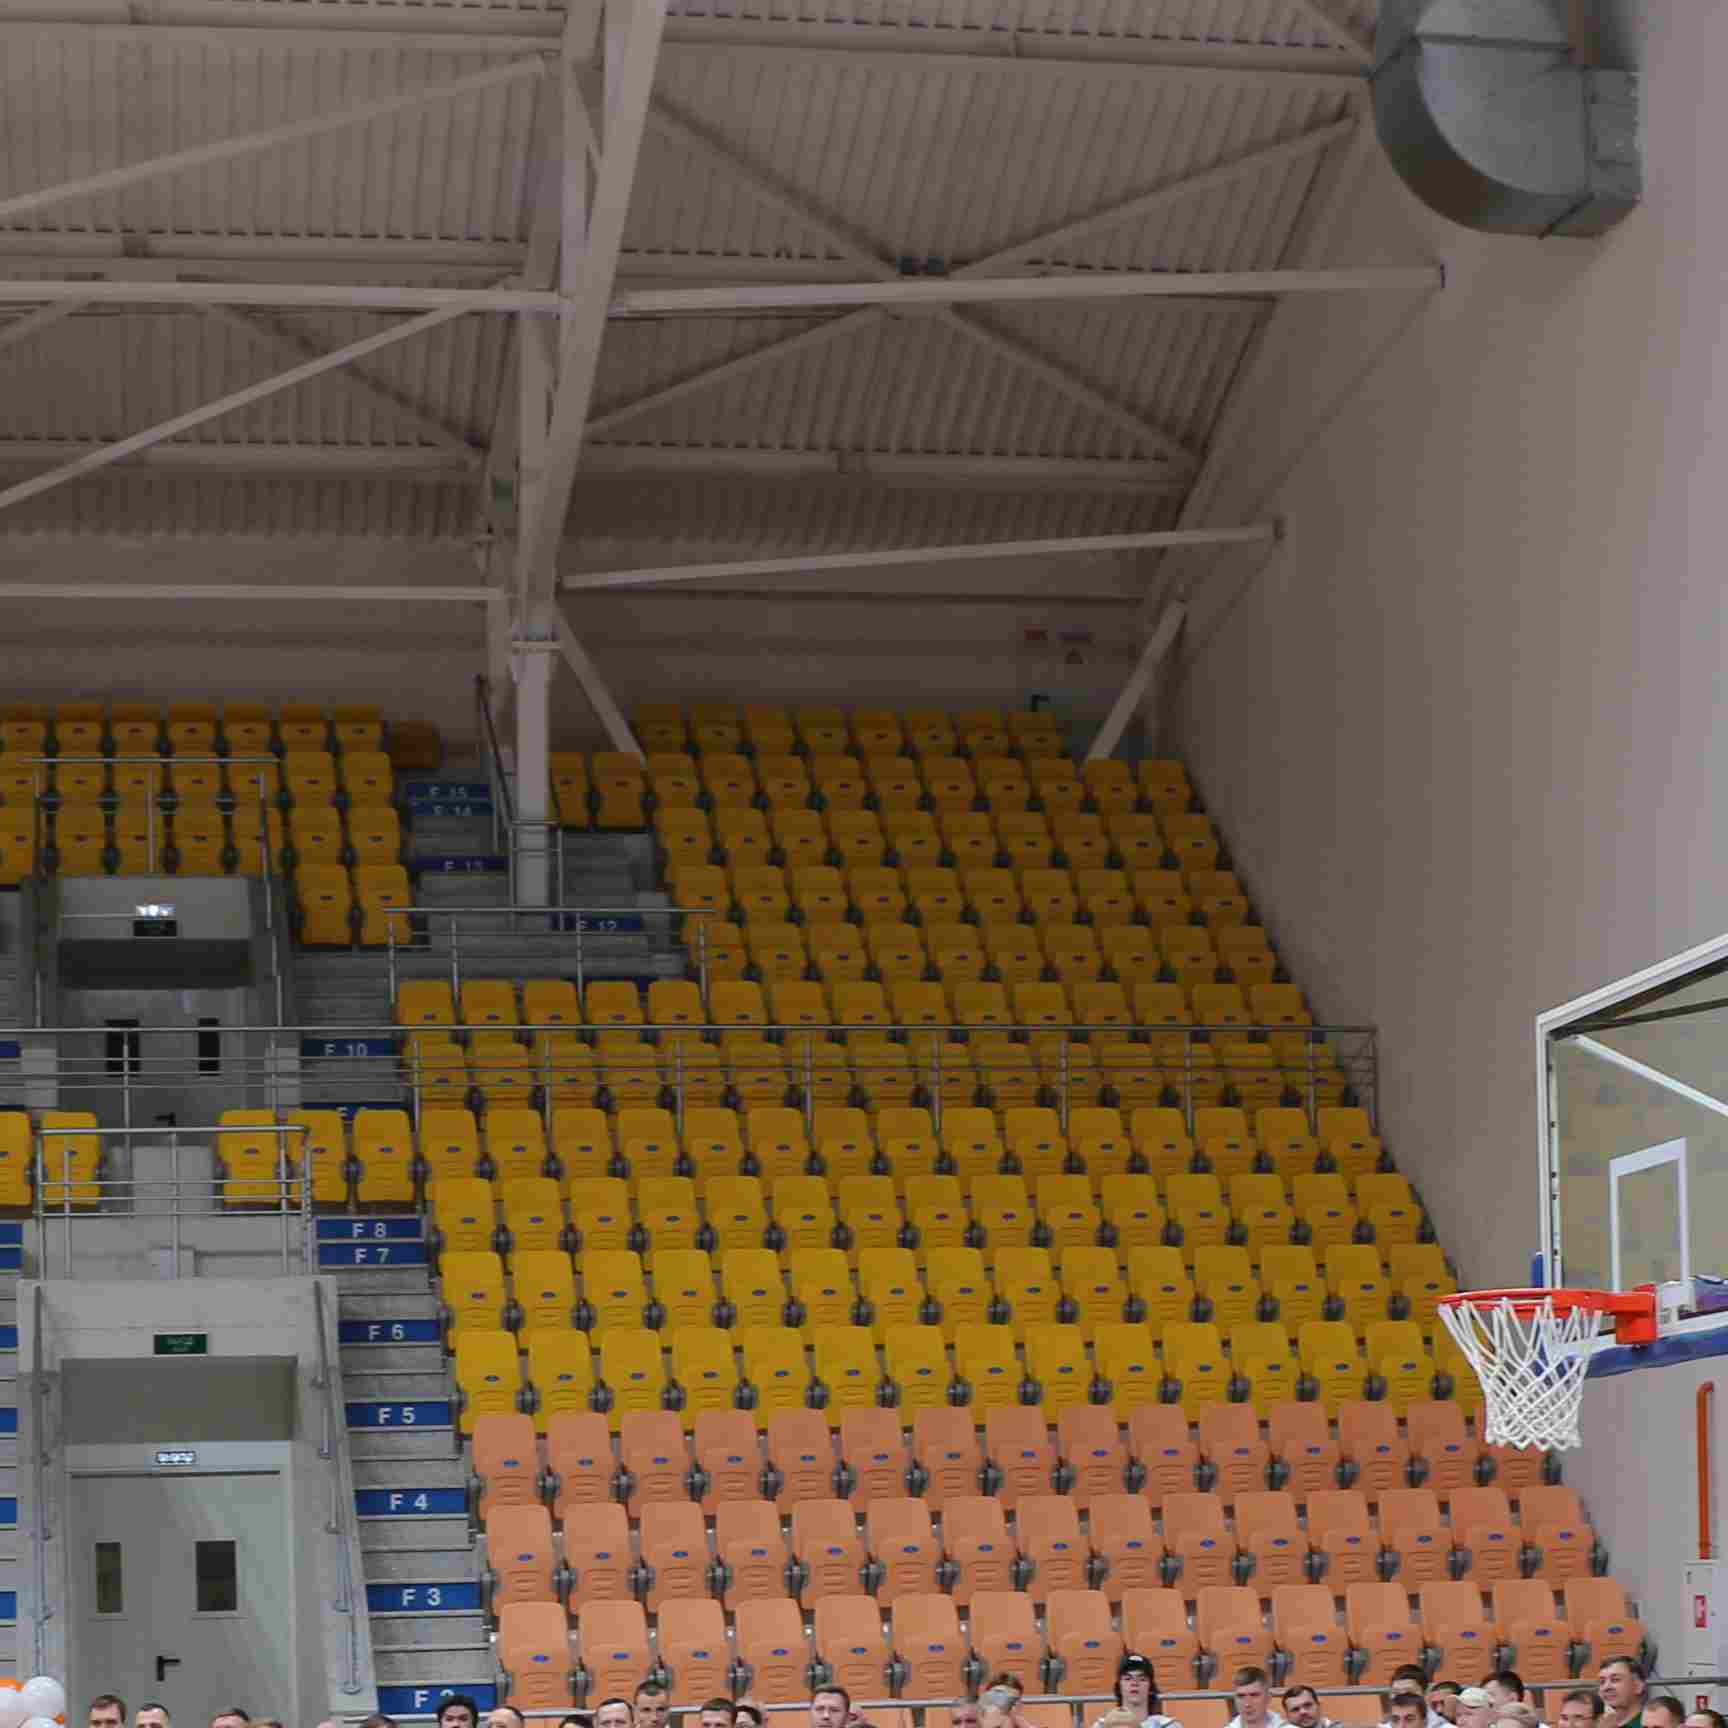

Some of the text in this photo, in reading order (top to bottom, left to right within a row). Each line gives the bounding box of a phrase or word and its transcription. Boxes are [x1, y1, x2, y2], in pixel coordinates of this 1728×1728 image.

[352, 1222, 386, 1238] F 8
[355, 1247, 389, 1264] F 7
[368, 1324, 403, 1340] F 6
[378, 1406, 415, 1424] F 5
[390, 1493, 428, 1510] F 4
[402, 1587, 441, 1606] F 3
[414, 1689, 429, 1709] F
